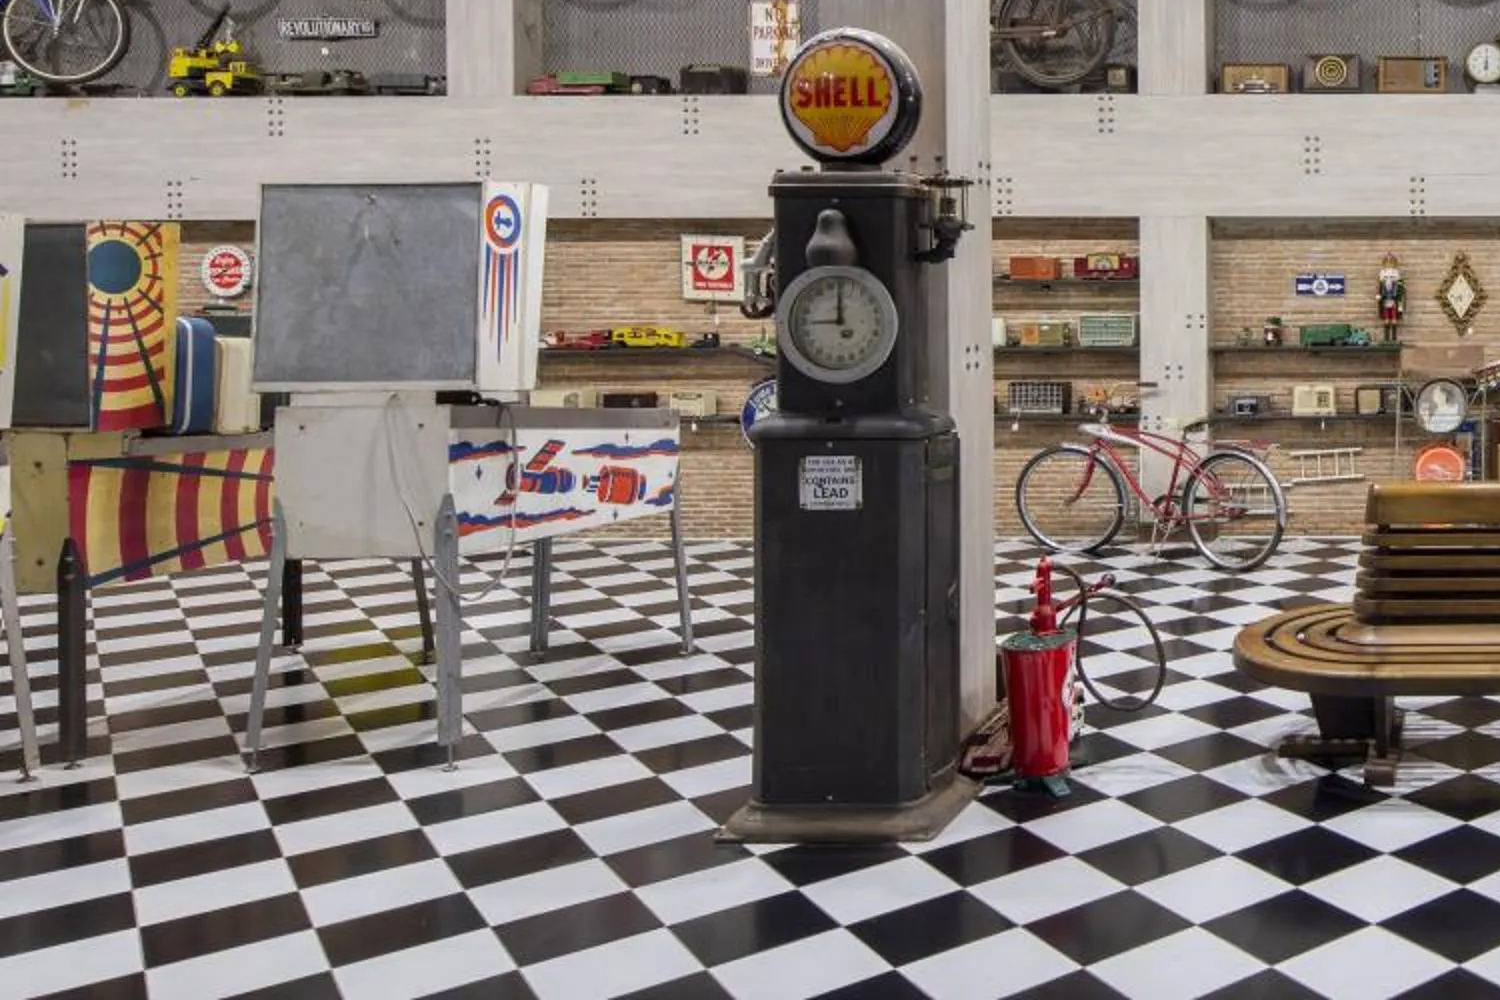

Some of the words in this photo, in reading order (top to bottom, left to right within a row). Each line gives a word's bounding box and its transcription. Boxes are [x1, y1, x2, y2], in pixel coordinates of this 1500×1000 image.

[796, 75, 882, 109] SHELL
[805, 475, 855, 486] CONTAINS
[813, 487, 849, 499] LEAD
